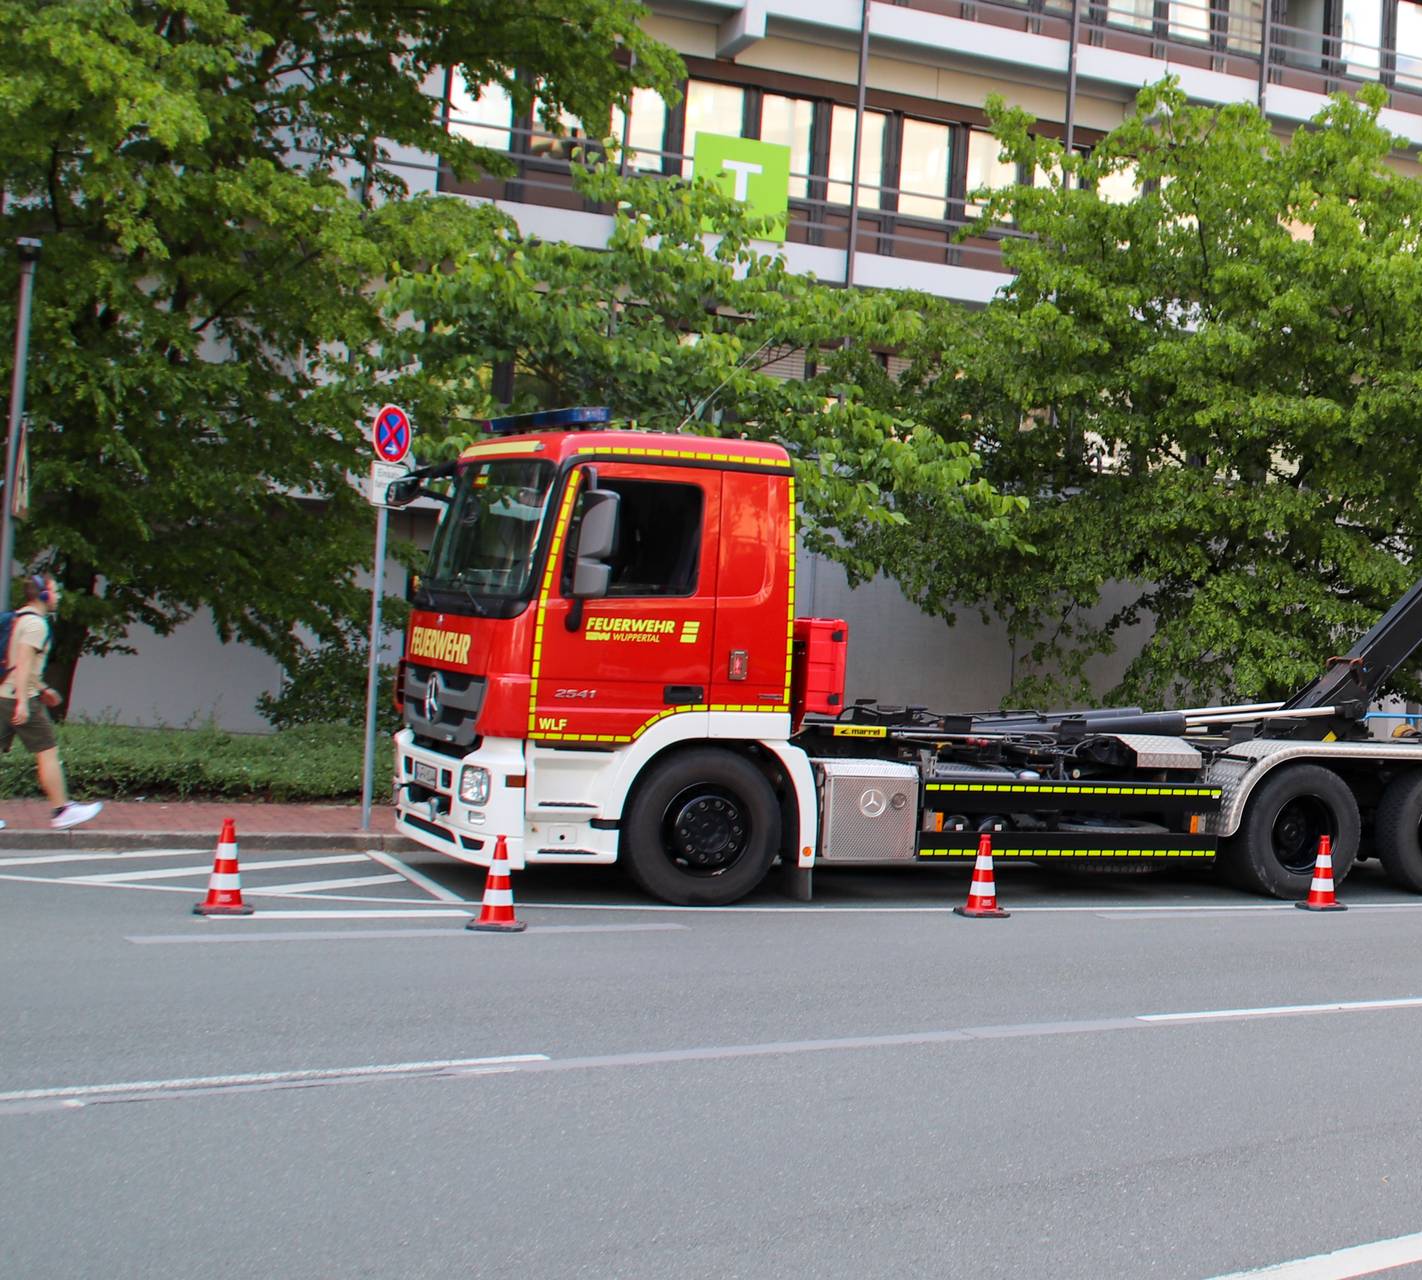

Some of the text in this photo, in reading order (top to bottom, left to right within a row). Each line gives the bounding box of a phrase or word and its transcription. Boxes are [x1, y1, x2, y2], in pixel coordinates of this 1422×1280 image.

[722, 159, 763, 203] T
[586, 617, 676, 634] FEUERWEHR
[612, 632, 660, 643] WUPPERTAL
[410, 626, 472, 665] FEUERWEHR
[554, 688, 597, 699] 2541
[538, 717, 567, 730] WLF
